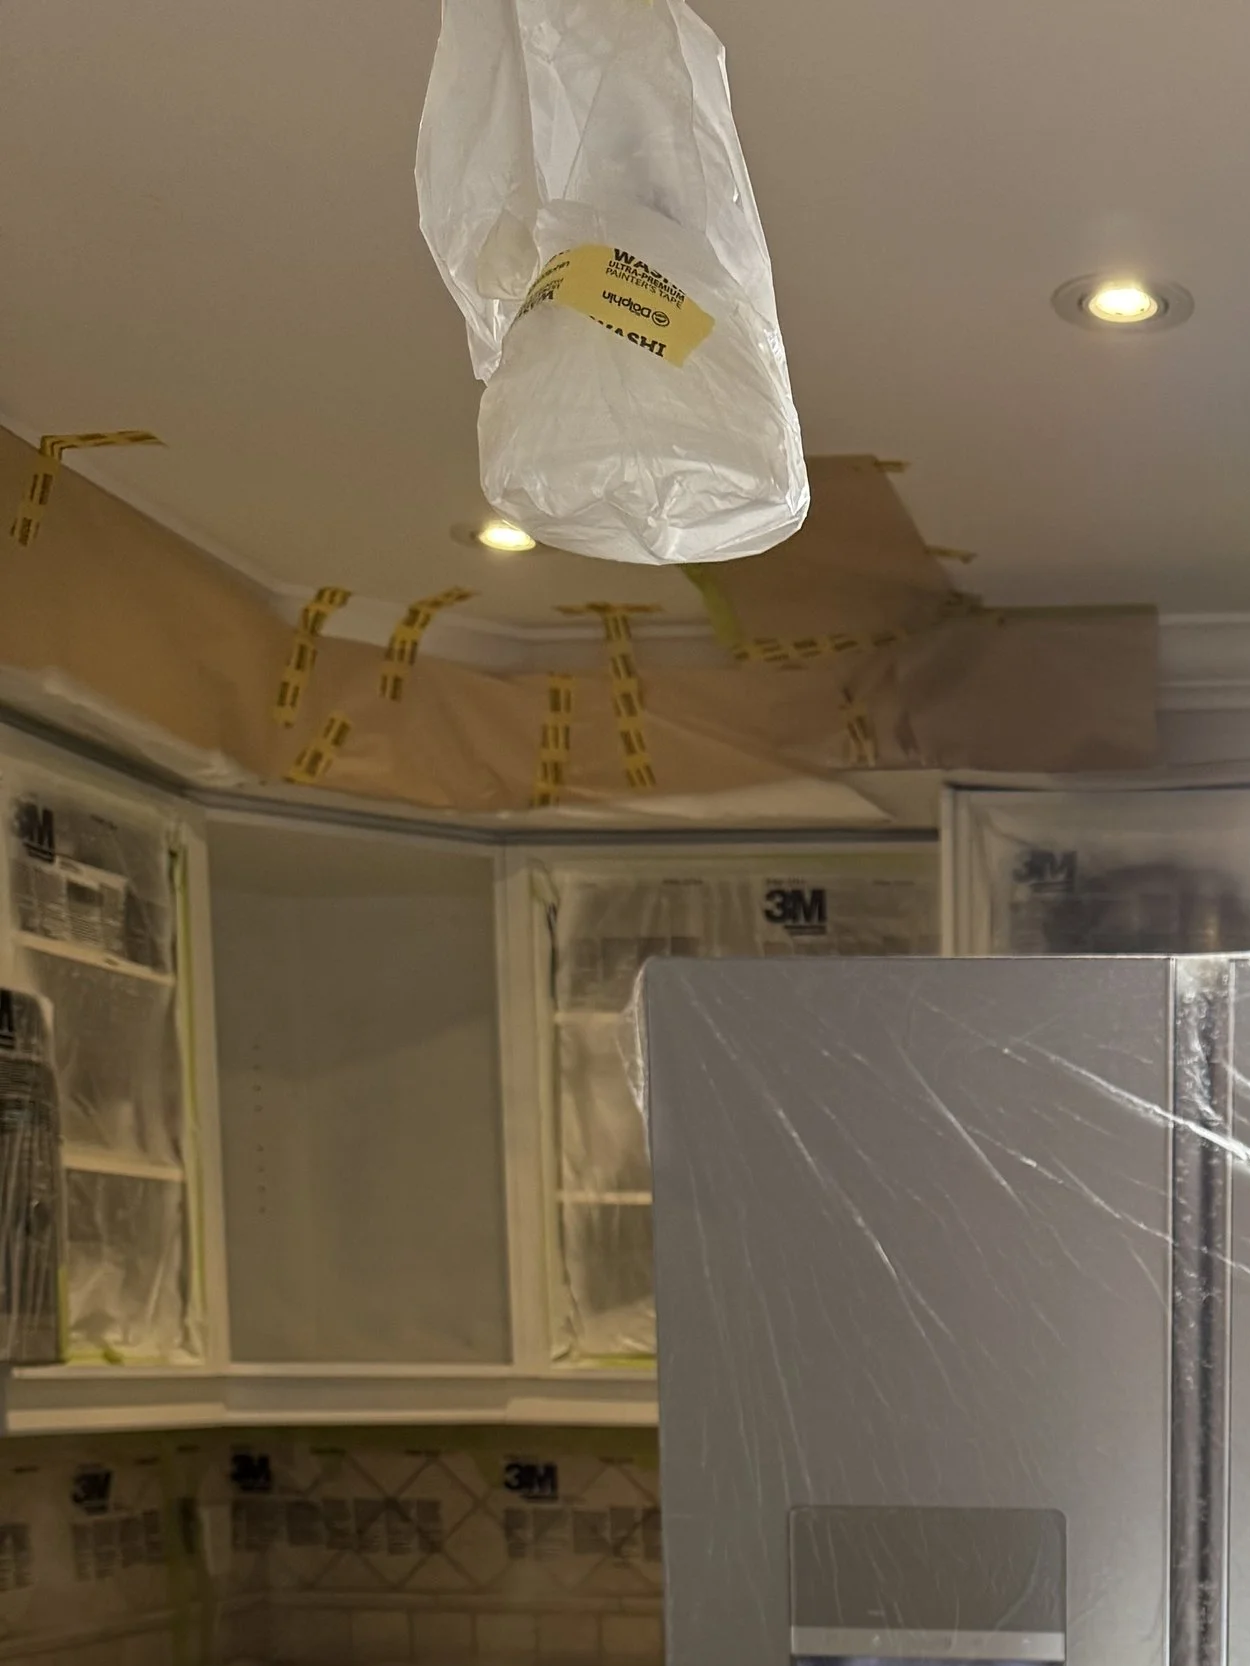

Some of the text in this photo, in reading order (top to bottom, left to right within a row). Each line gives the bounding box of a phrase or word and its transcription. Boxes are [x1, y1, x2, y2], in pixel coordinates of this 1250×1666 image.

[602, 289, 652, 319] Dolphin
[658, 290, 683, 310] TAPE
[764, 888, 827, 923] 3M
[504, 1464, 558, 1495] 3M
